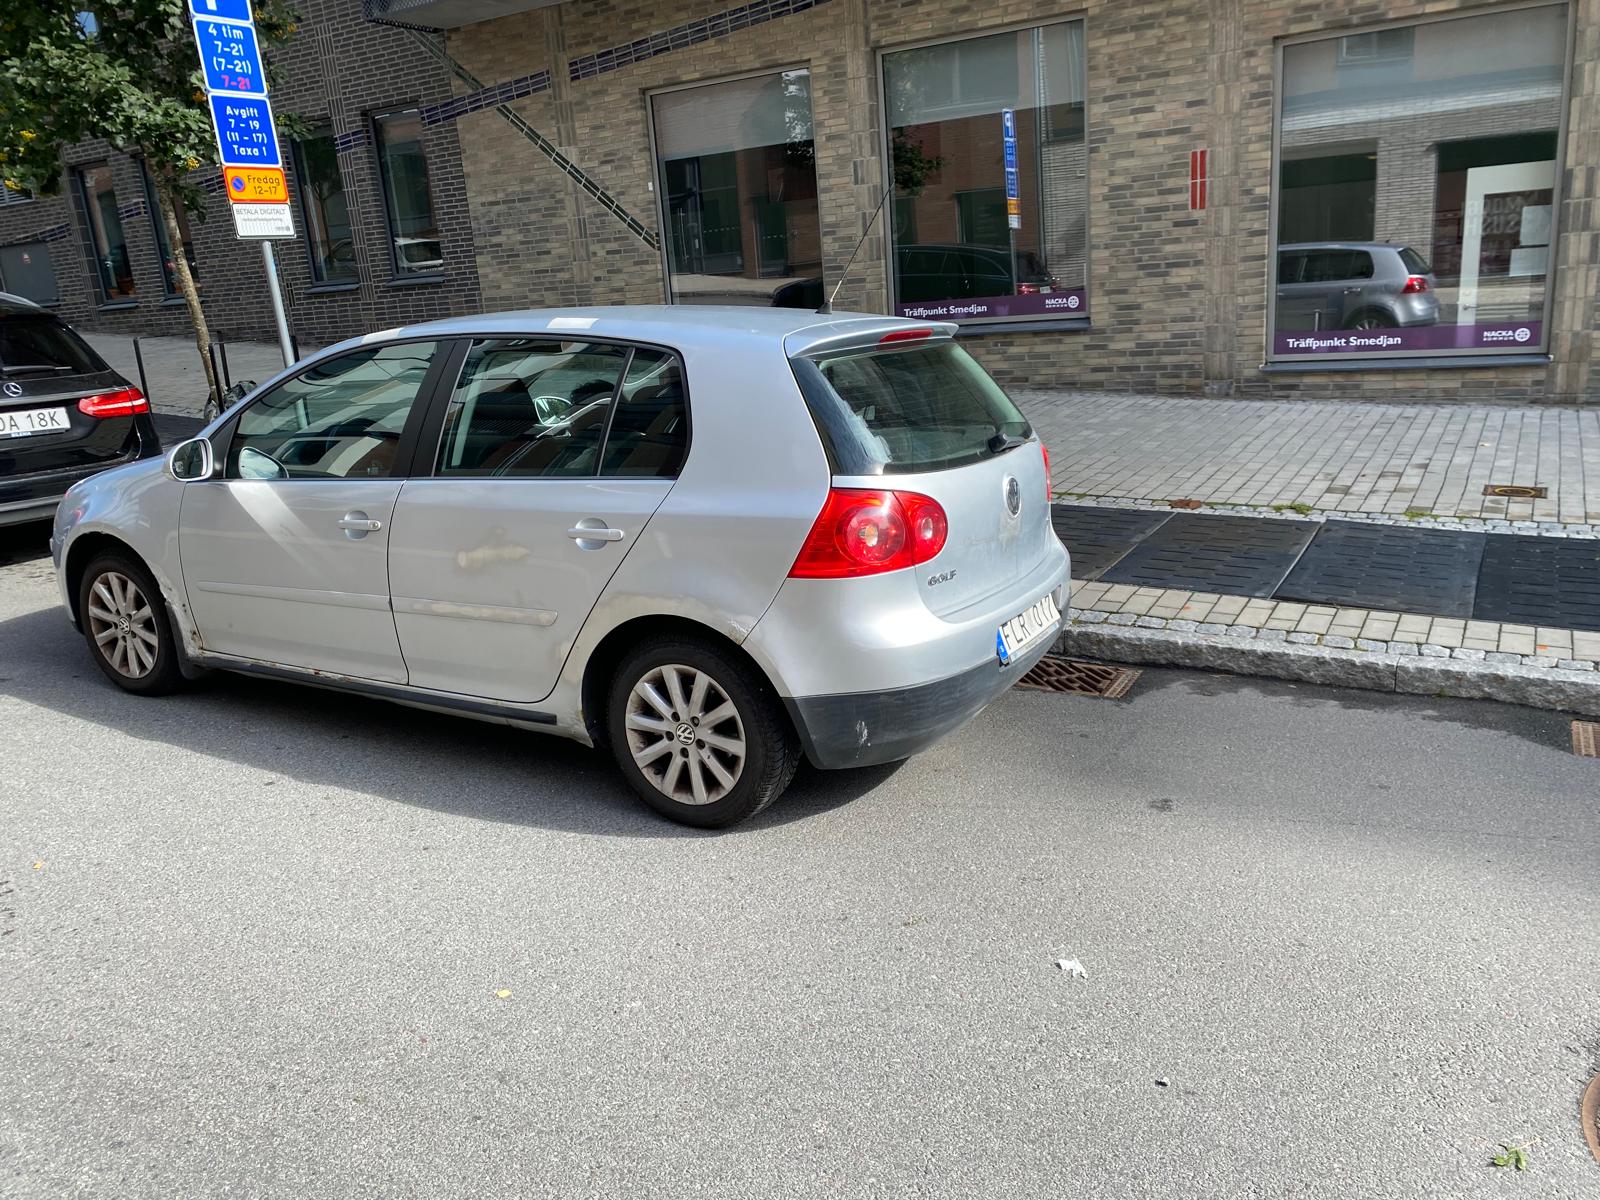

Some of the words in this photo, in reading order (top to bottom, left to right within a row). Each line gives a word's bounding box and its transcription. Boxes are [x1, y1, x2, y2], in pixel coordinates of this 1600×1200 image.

[208, 23, 217, 37] 4
[222, 25, 244, 40] tim
[213, 40, 244, 57] 7-21
[213, 56, 252, 75] (7-21)
[221, 74, 251, 91] 7-21
[226, 105, 258, 119] Avgift
[229, 118, 235, 129] 7
[249, 120, 260, 131] 19
[226, 130, 240, 142] (11
[252, 132, 268, 145] 17)
[232, 144, 259, 157] Taxa
[262, 146, 267, 157] 1
[247, 174, 280, 187] Fredag
[253, 186, 278, 195] 12-17
[235, 208, 259, 216] BETALA
[260, 208, 286, 216] DIGITALT
[1045, 297, 1068, 305] NACKA
[904, 306, 948, 318] Träffpunkt
[949, 304, 988, 315] Smedjan
[1286, 337, 1347, 350] Träffpunkt
[1349, 335, 1402, 347] Smedjan
[26, 410, 61, 429] 18K
[928, 569, 957, 586] GOLF
[1001, 614, 1031, 650] FLR
[1032, 595, 1054, 627] 017
